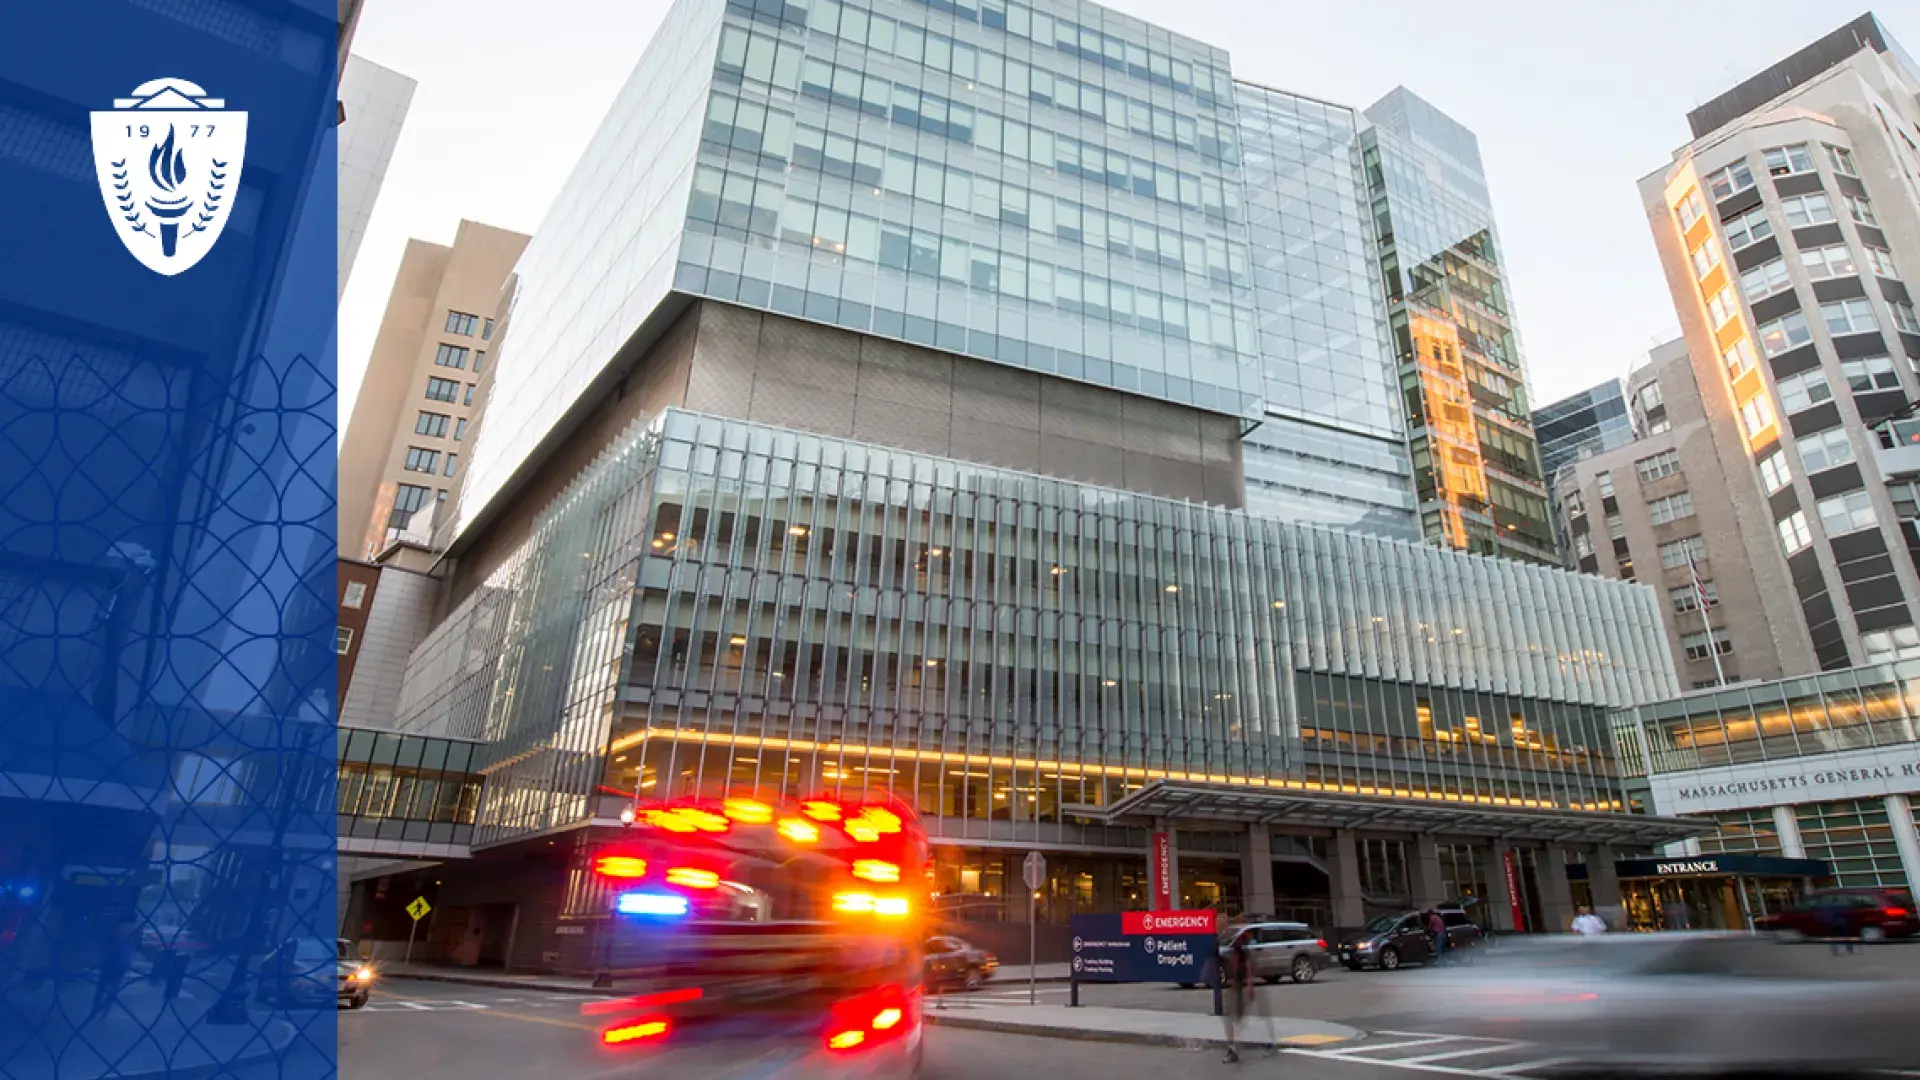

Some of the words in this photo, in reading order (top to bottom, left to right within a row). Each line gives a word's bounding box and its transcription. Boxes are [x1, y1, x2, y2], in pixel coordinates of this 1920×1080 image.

[1678, 775, 1808, 799] MASSACHUSETTS
[1813, 765, 1896, 785] GENERAL
[1160, 836, 1169, 895] EMERGENCY
[1656, 860, 1719, 875] ENTRANCE
[1155, 915, 1209, 928] EMERGENCY
[1157, 940, 1187, 951] Patient
[1157, 953, 1194, 967] Drop-Off
